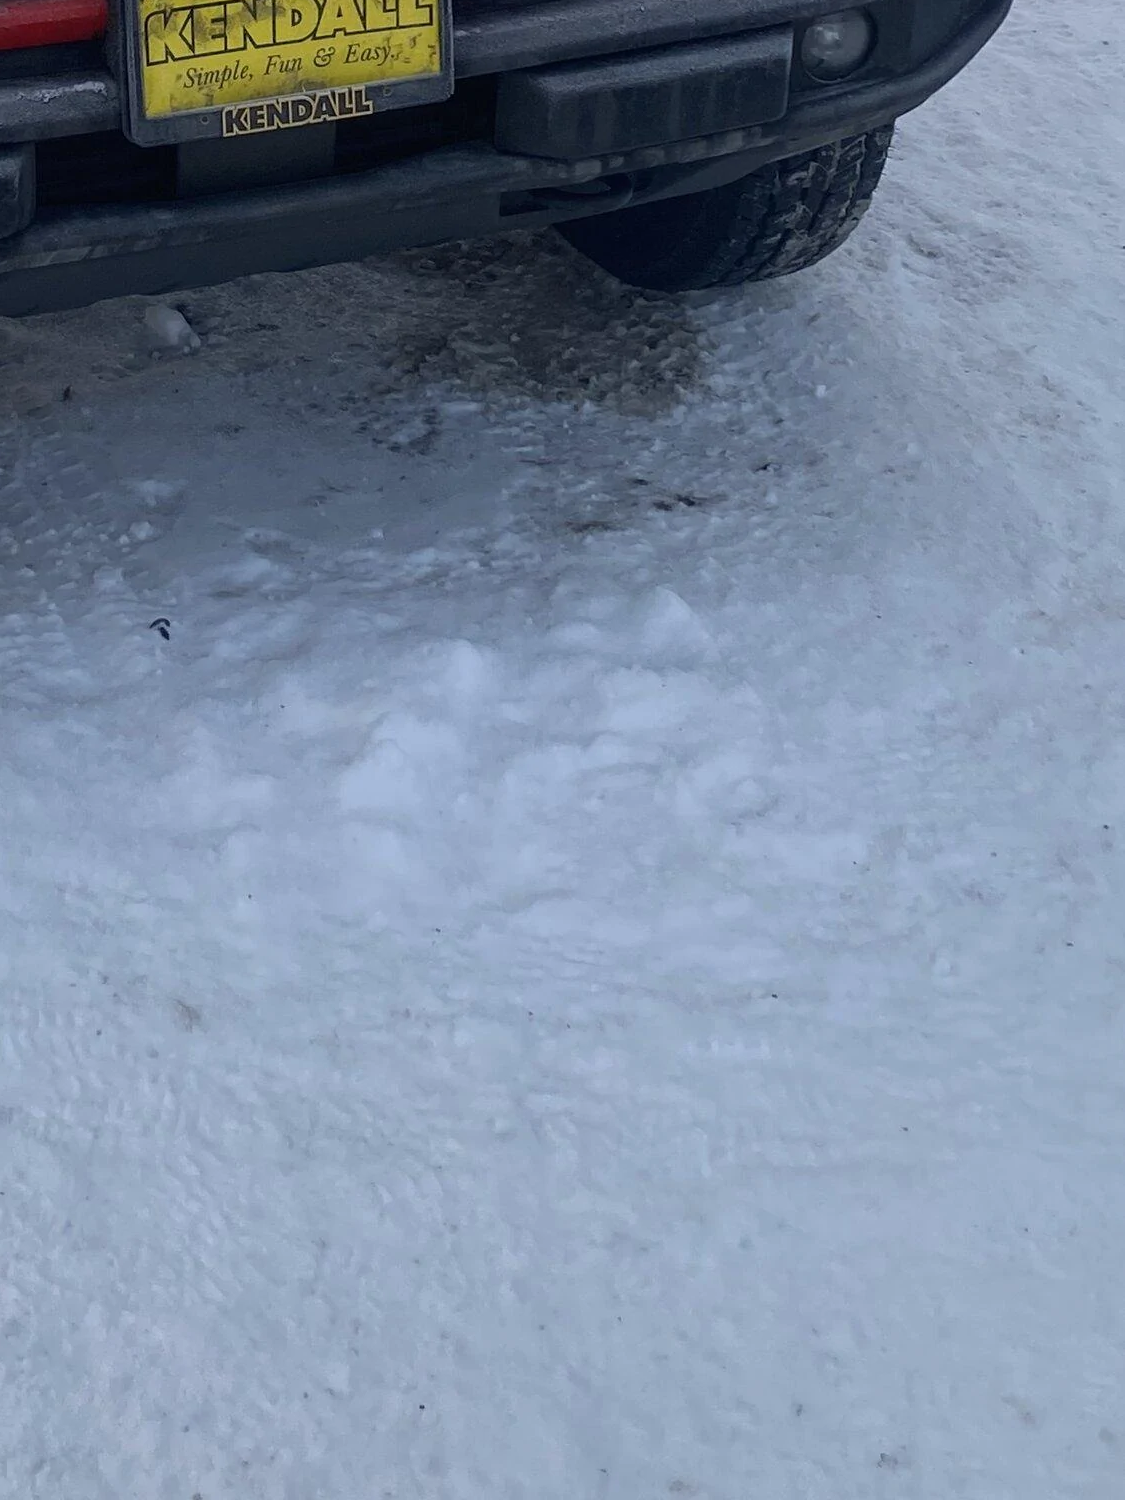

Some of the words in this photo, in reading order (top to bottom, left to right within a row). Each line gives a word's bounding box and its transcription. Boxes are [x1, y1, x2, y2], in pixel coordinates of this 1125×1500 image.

[183, 60, 253, 89] Simple,
[264, 54, 303, 76] Fun
[313, 47, 336, 67] &
[343, 43, 396, 66] Easy.
[222, 85, 374, 137] KENDALL
